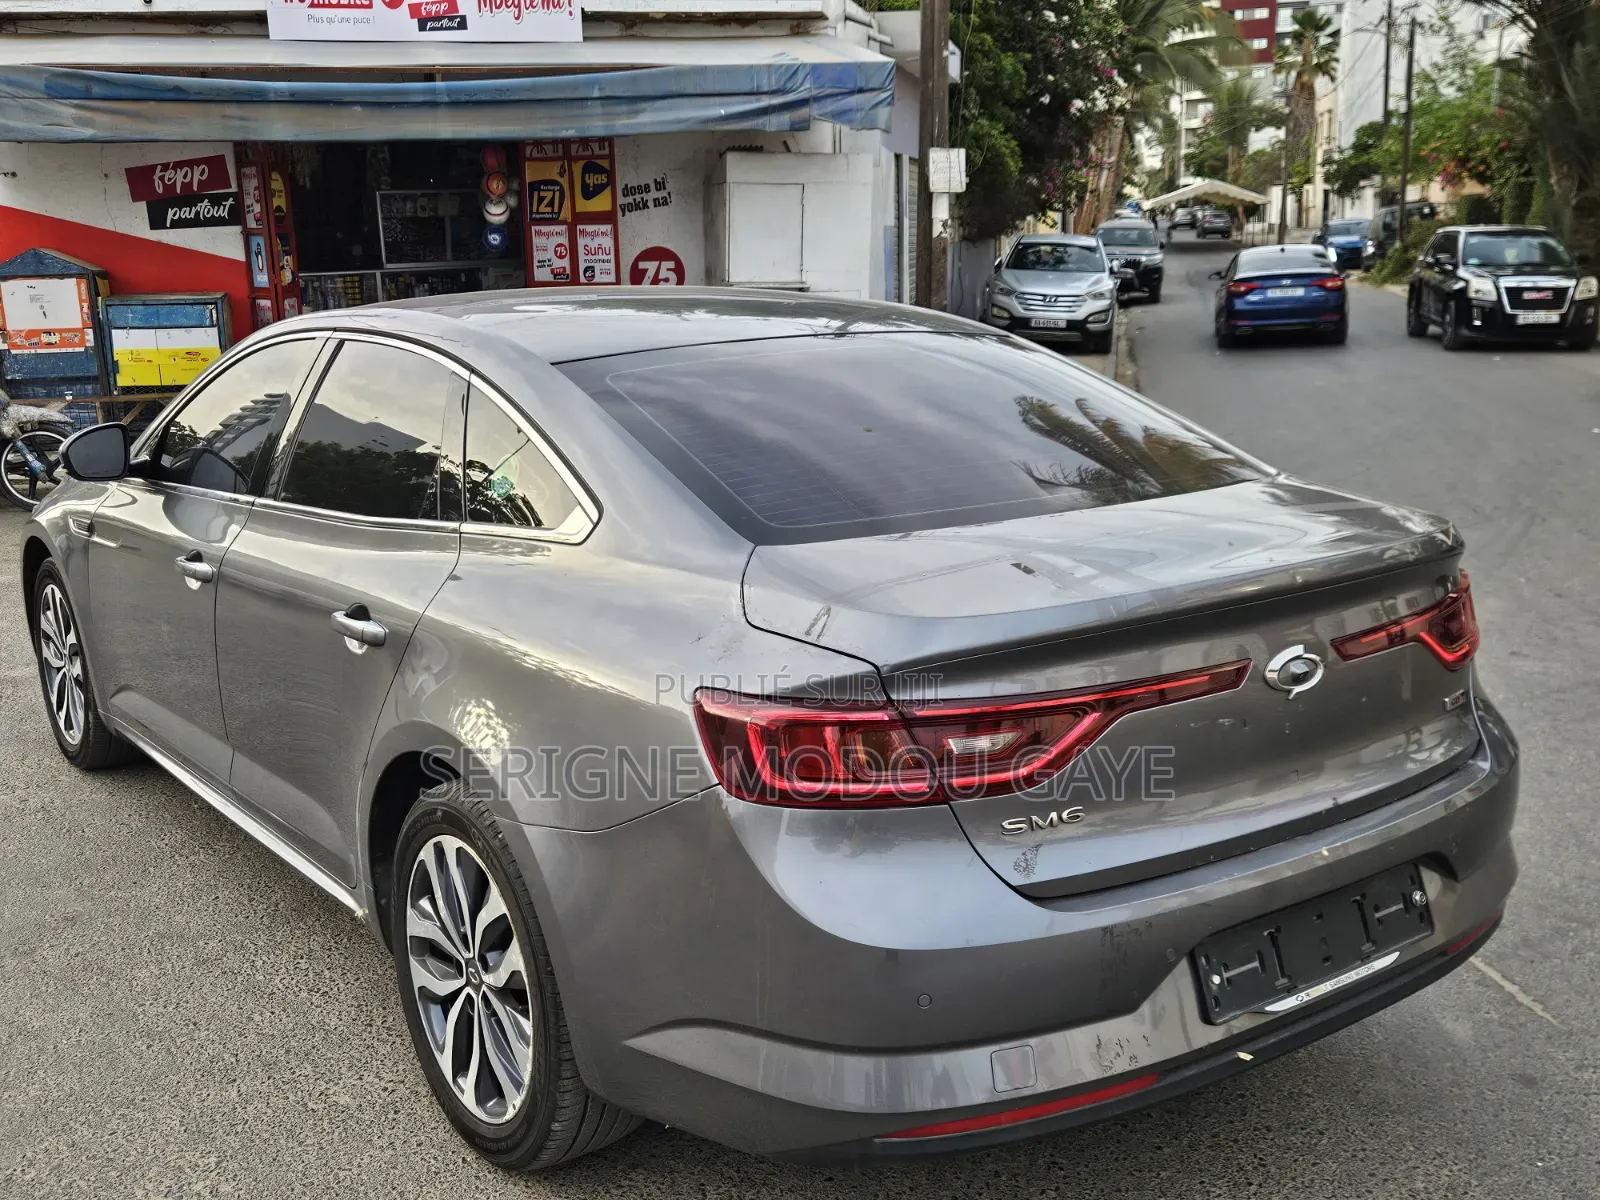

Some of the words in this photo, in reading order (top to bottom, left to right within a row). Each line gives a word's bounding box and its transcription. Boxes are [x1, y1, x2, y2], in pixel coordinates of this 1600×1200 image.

[307, 14, 325, 24] Plus
[326, 15, 351, 25] qu'une
[353, 16, 371, 25] puce
[426, 18, 461, 31] partout
[152, 162, 209, 194] fépp
[585, 173, 608, 191] yas
[532, 191, 560, 213] IZI
[621, 183, 651, 199] dose
[166, 197, 236, 228] partout
[619, 196, 650, 218] yokk
[652, 191, 673, 208] na!
[638, 261, 678, 285] 75
[1001, 806, 1086, 835] SM6
